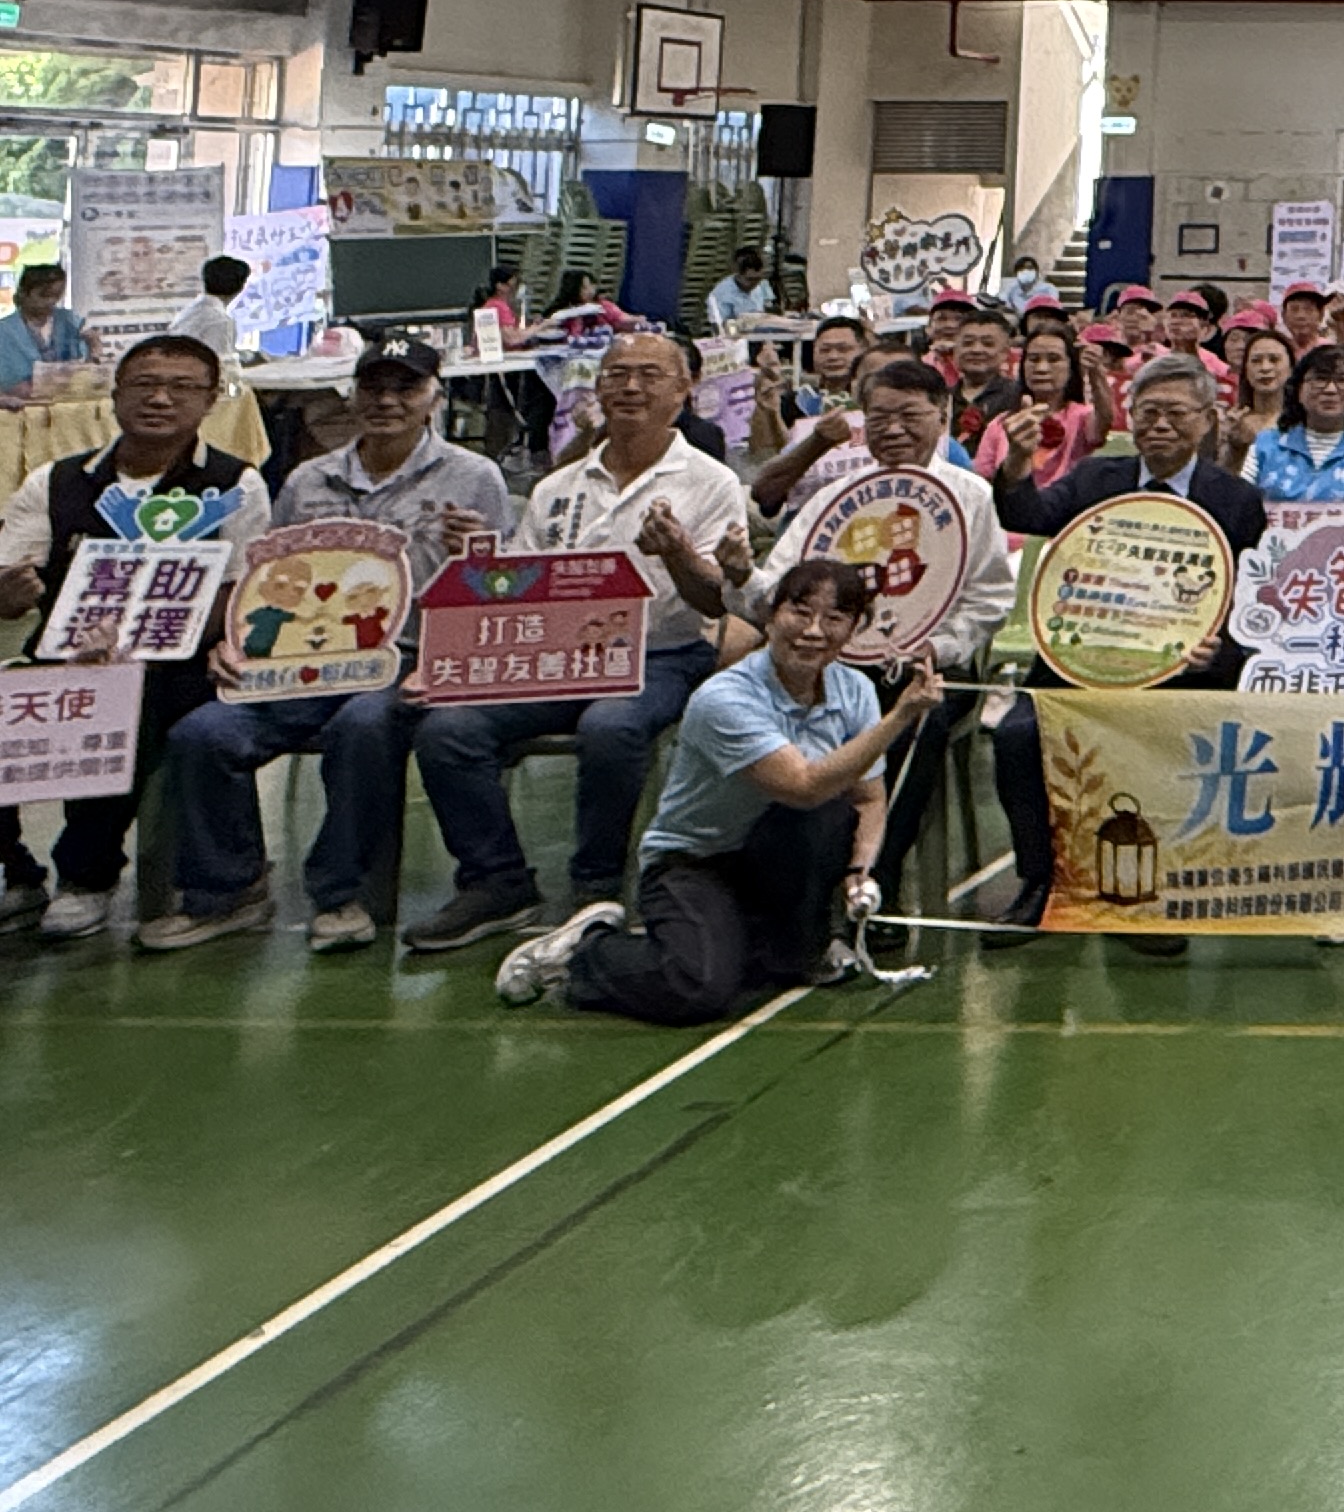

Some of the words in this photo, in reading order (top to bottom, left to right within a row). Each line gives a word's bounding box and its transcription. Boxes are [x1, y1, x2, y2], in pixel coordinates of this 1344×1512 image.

[79, 556, 209, 605] 幫助
[477, 614, 545, 646] 打造
[433, 647, 633, 686] 失智友善社區
[0, 688, 96, 726] 天使
